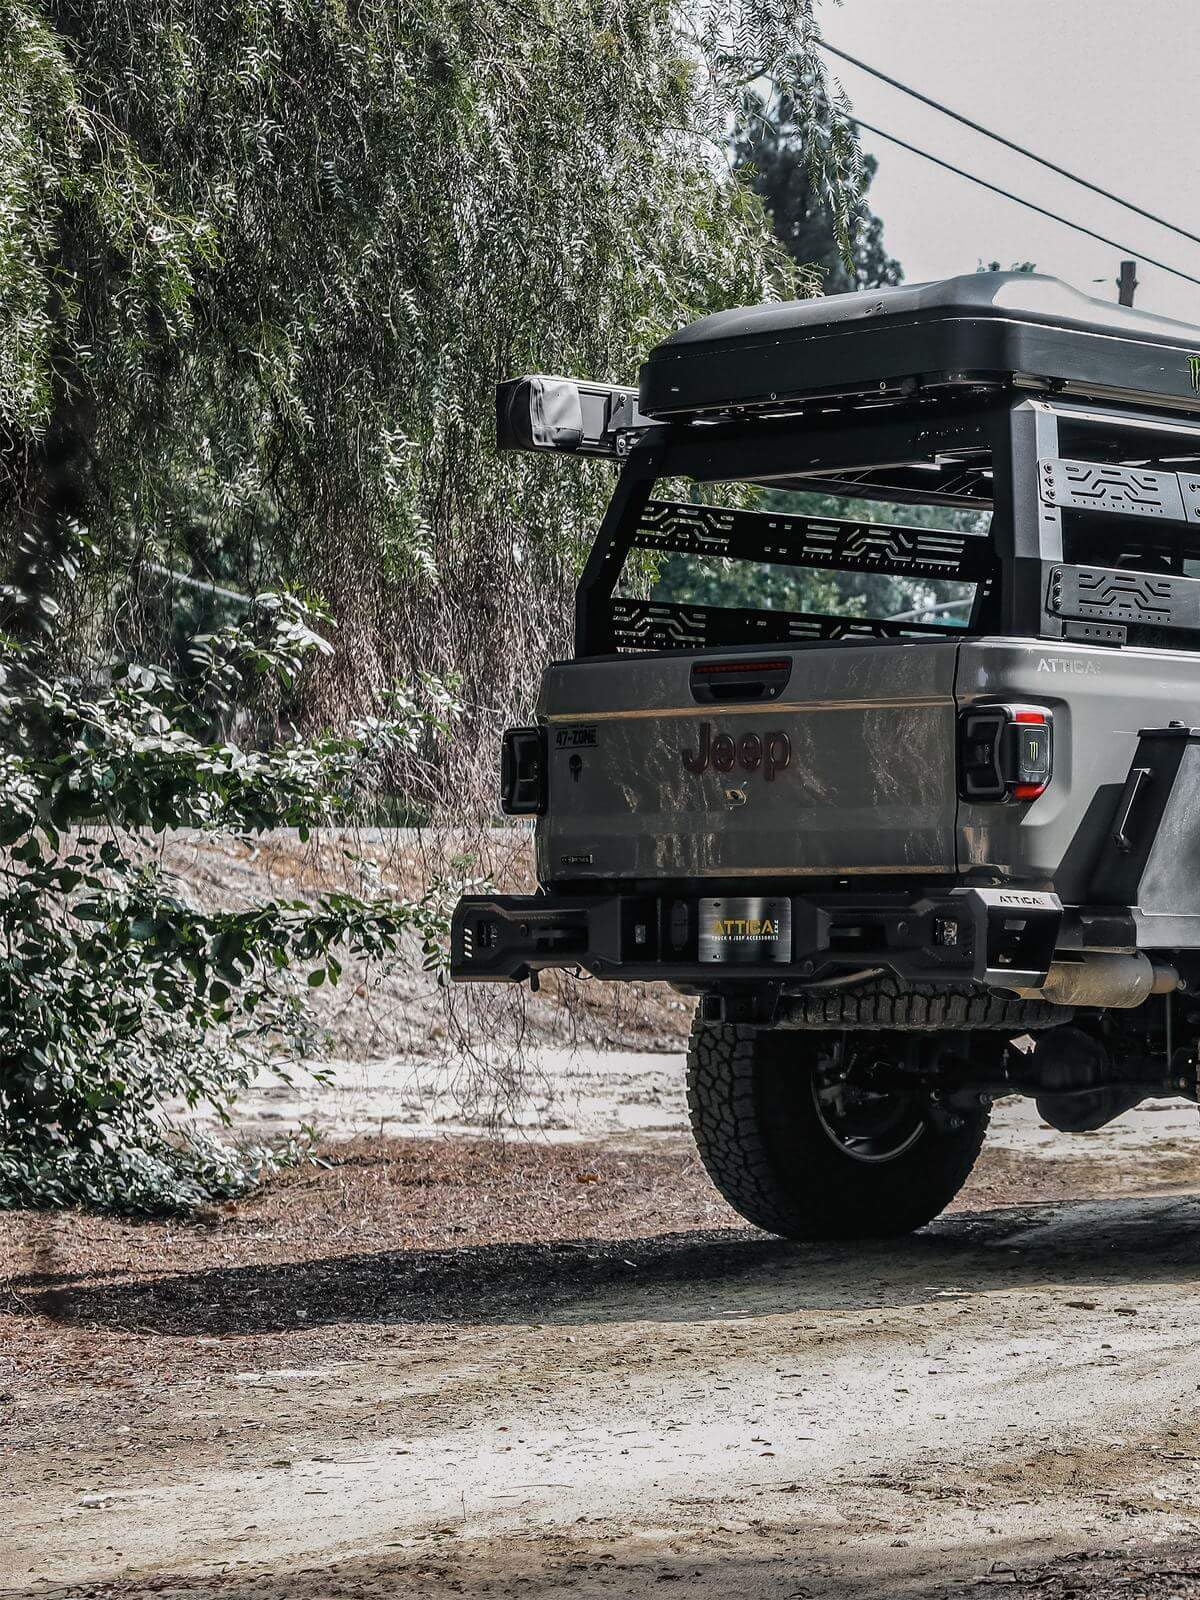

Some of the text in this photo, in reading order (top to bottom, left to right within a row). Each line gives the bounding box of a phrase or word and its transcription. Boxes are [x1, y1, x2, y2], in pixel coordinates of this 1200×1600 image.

[1037, 658, 1097, 675] ATTICA
[681, 721, 792, 782] Jeep
[1000, 895, 1042, 905] ATTICA
[712, 919, 774, 935] ATTICA
